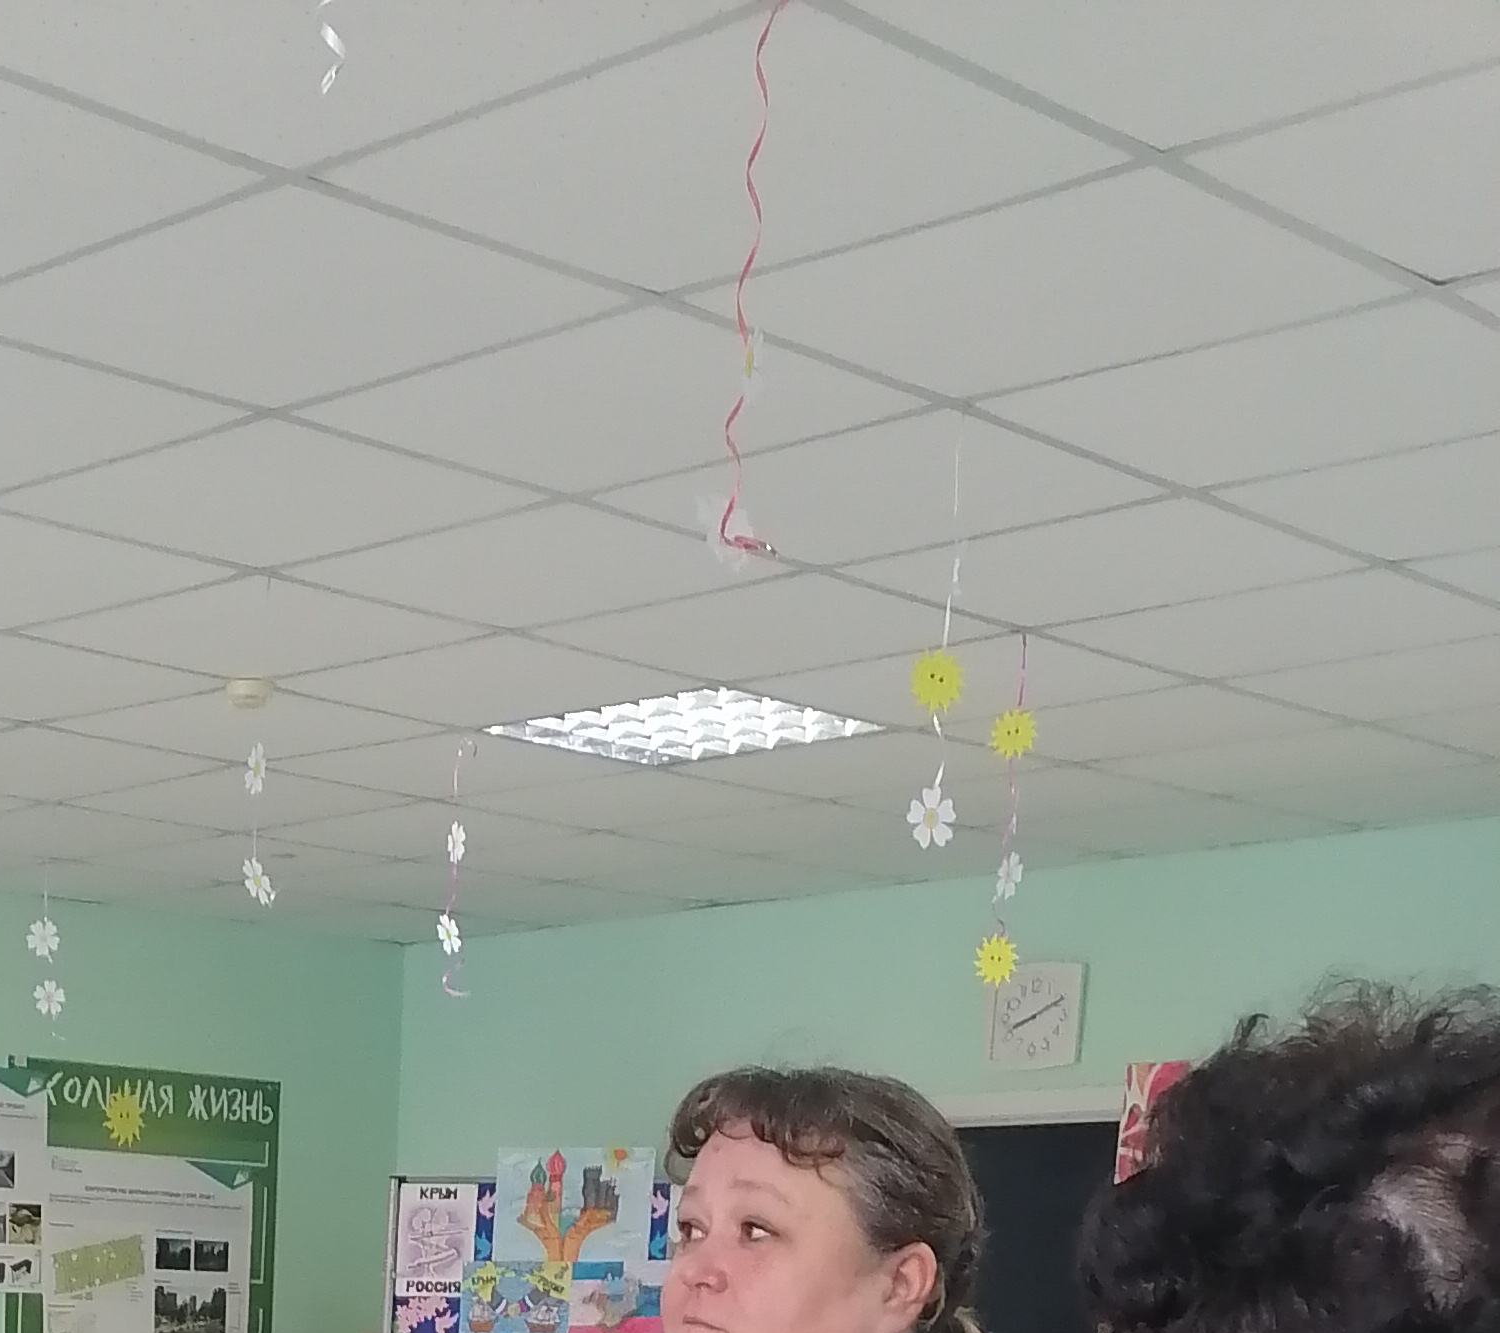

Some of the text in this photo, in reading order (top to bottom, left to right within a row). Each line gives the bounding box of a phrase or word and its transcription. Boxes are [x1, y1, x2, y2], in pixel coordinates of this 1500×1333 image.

[187, 1084, 274, 1125] ЖИЗНЬ
[419, 1187, 458, 1200] КРЫМ
[405, 1280, 461, 1293] РОССИЯ
